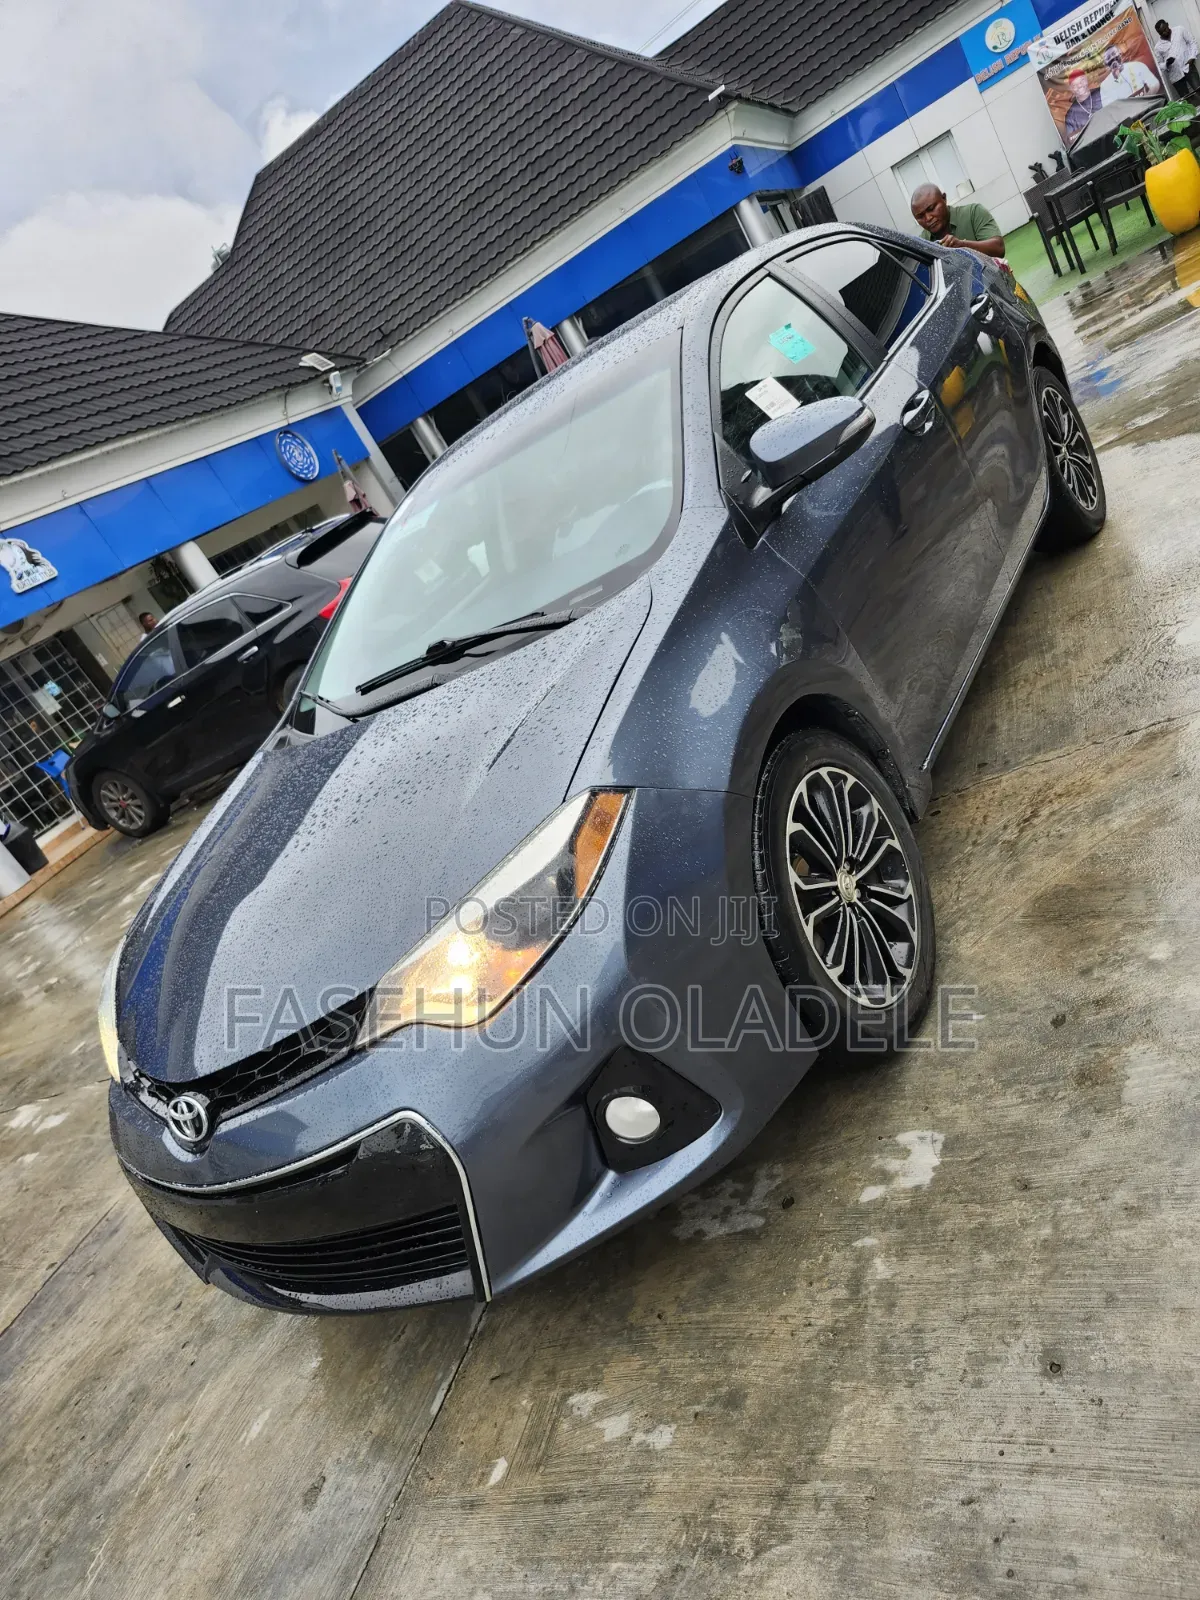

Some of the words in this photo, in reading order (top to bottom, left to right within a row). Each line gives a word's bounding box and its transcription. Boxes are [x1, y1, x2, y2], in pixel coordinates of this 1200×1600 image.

[1053, 20, 1083, 46] DELISH
[1065, 35, 1081, 50] BAR
[1086, 10, 1115, 35] LOUNGE
[975, 58, 1004, 85] DELISH
